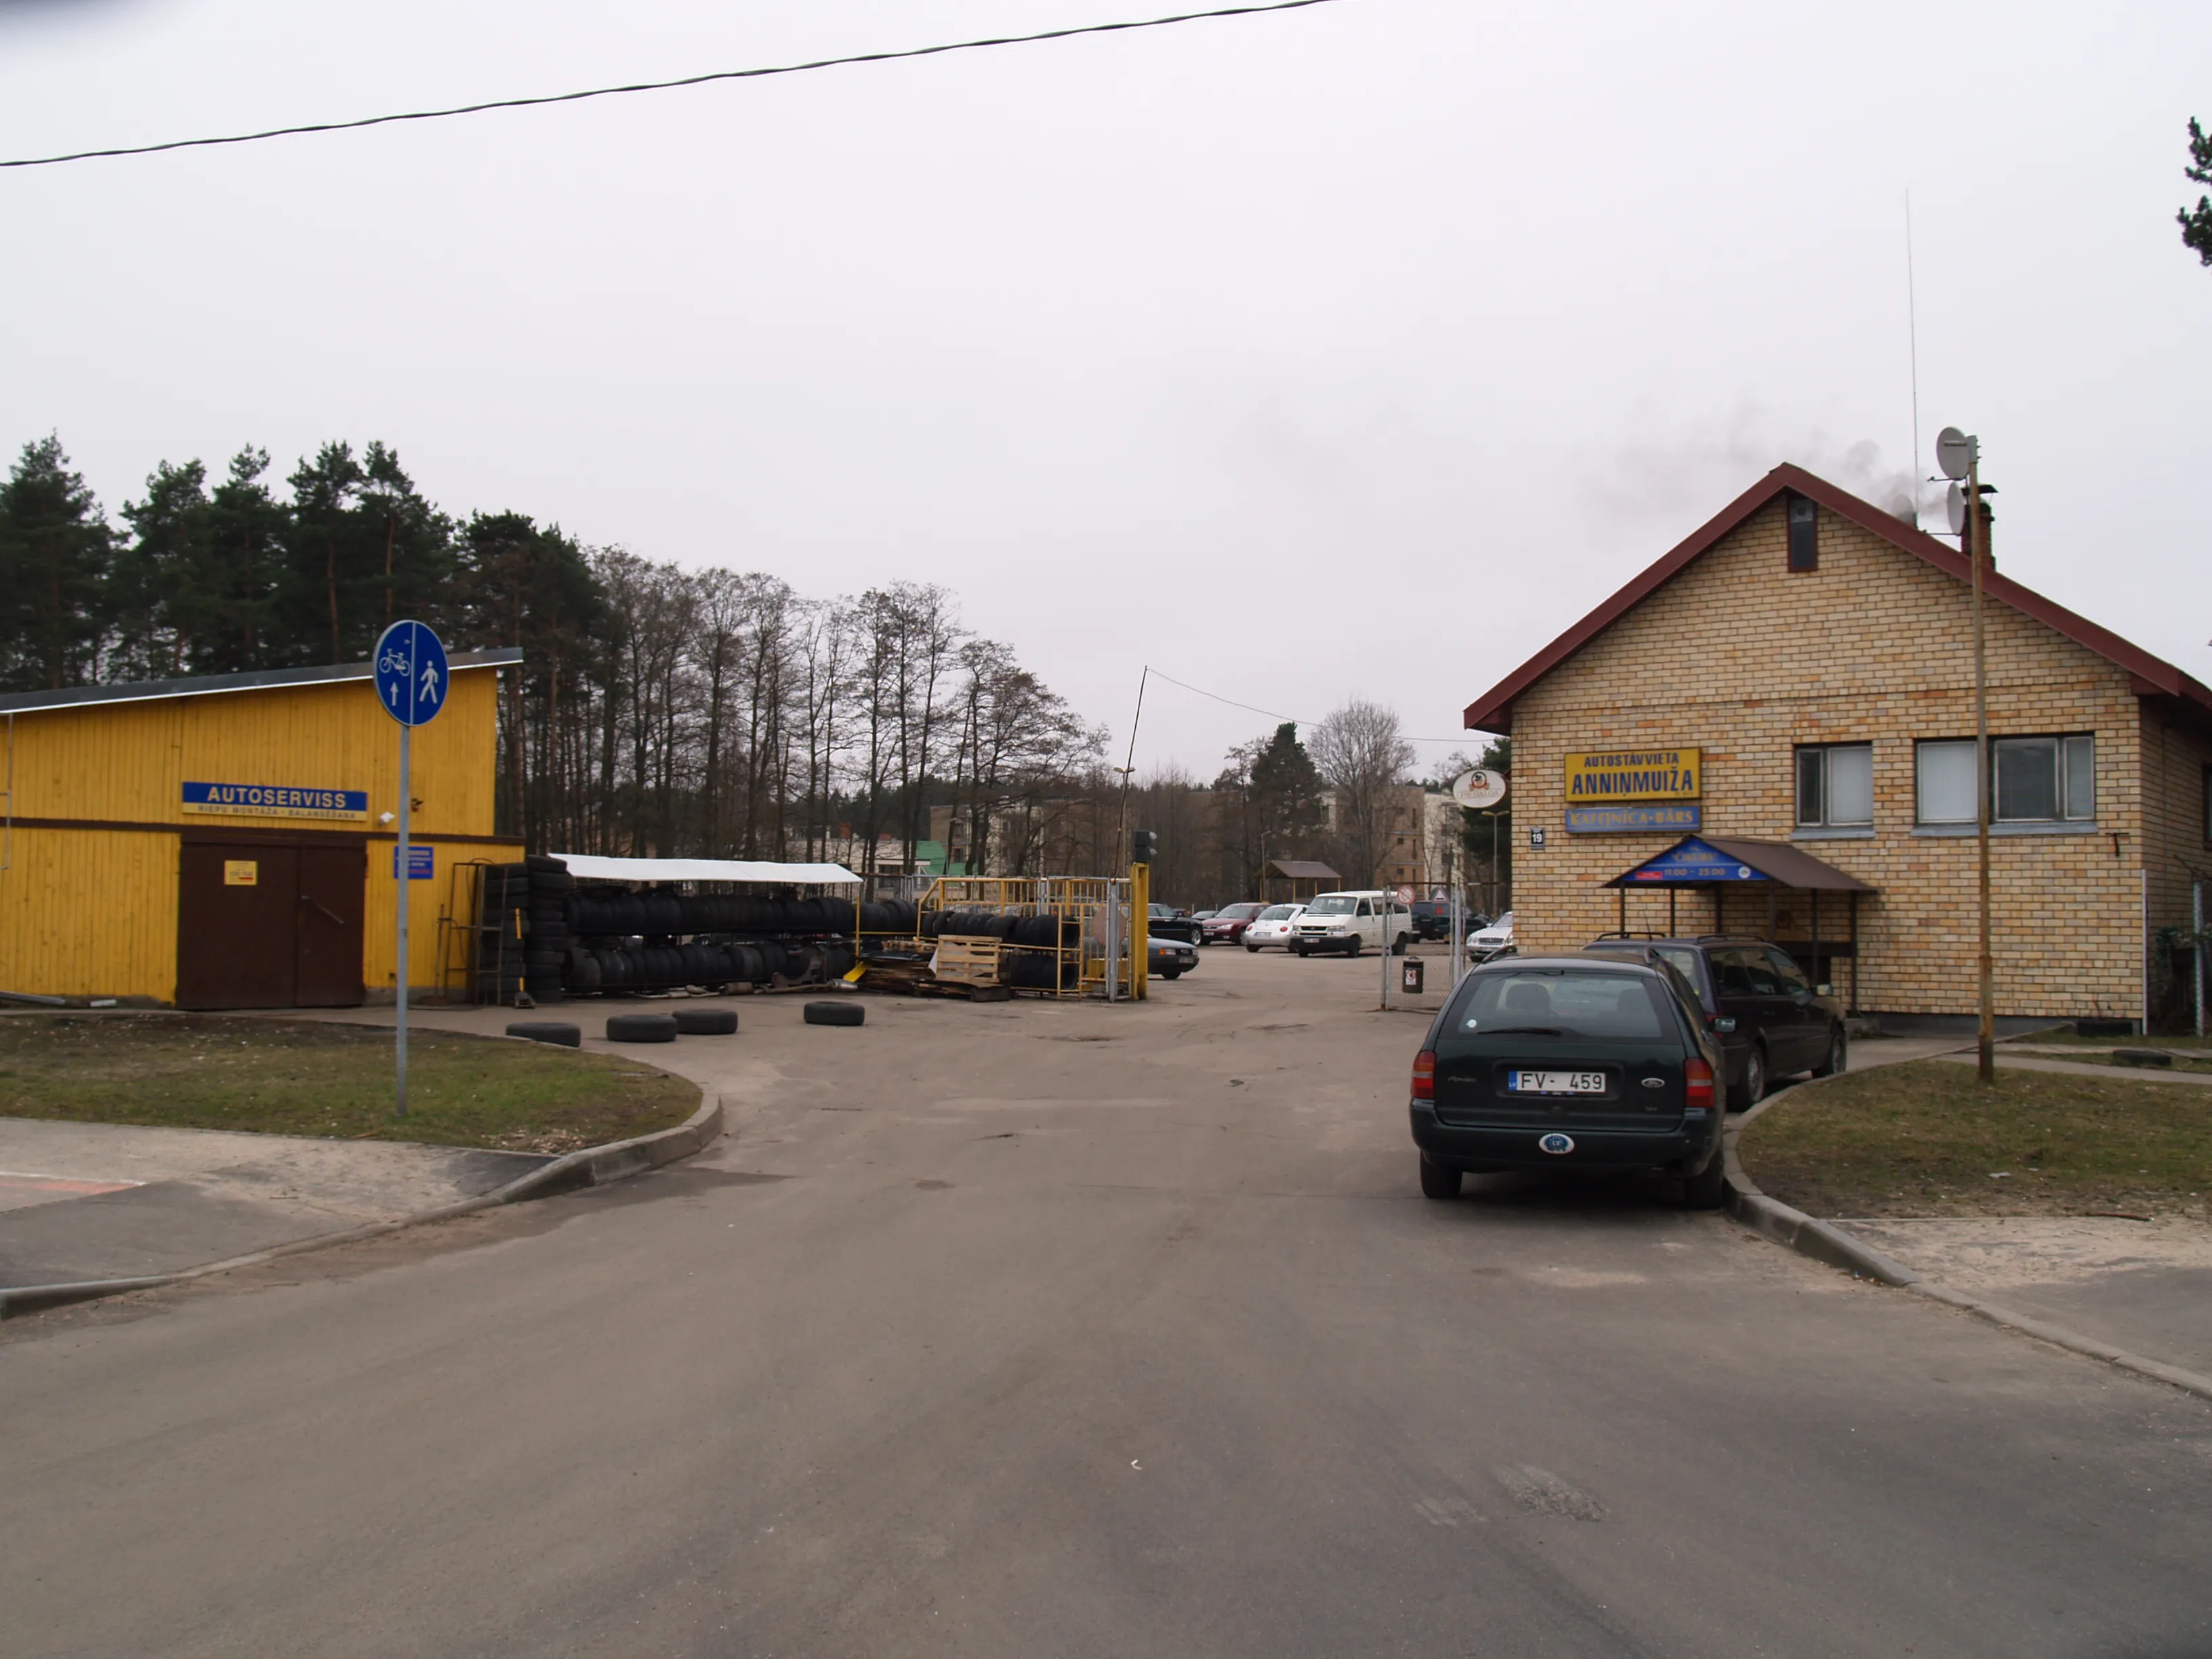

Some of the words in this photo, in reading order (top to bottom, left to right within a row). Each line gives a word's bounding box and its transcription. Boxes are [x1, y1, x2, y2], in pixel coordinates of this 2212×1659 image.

[1584, 753, 1679, 768] AUTOSTĀVVIETA
[1571, 766, 1694, 797] ANNIŅMUIŽA
[207, 786, 347, 808] AUTOSERVISS
[1532, 833, 1542, 843] 19
[1570, 1074, 1602, 1090] 459
